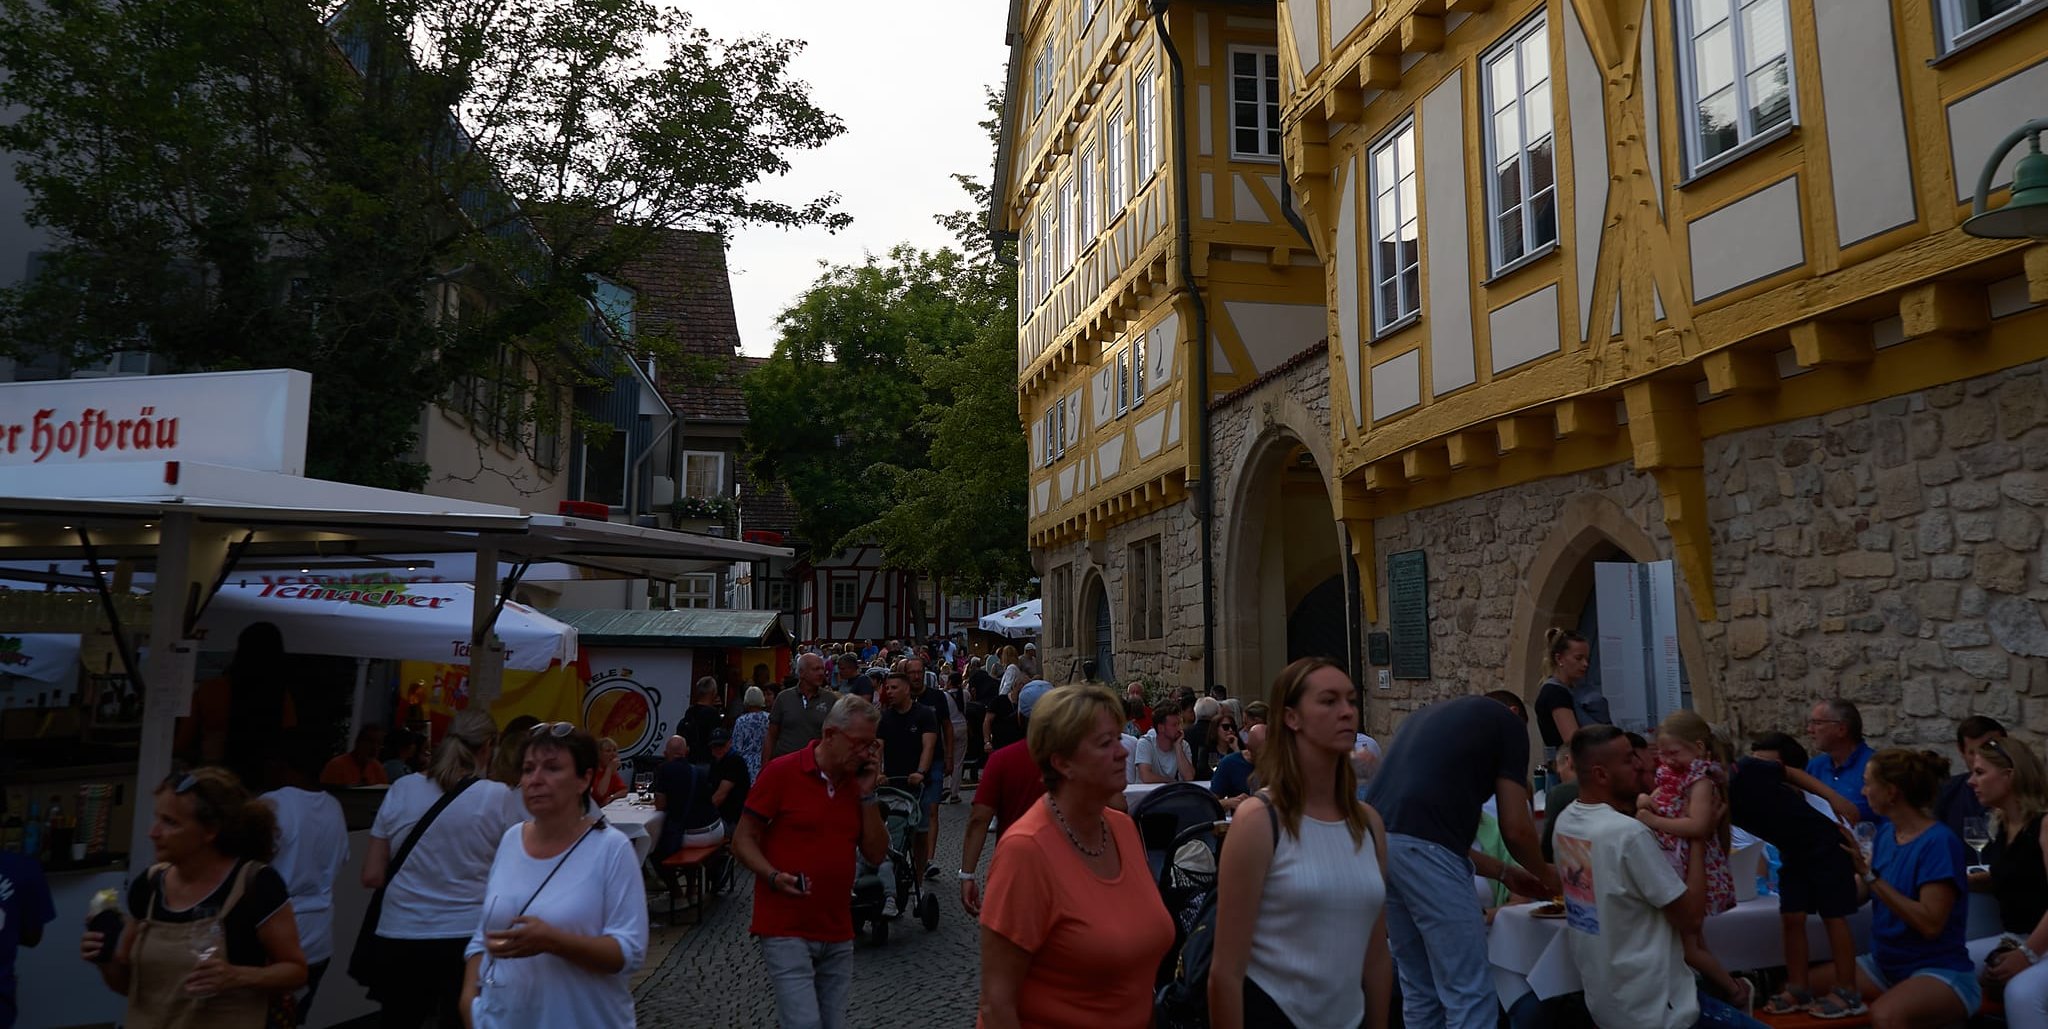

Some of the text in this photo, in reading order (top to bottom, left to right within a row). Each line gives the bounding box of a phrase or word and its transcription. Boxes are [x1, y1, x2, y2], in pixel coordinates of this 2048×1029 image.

[1102, 367, 1110, 416] 9
[1154, 328, 1164, 380] 2
[31, 406, 178, 463] Hofbräu
